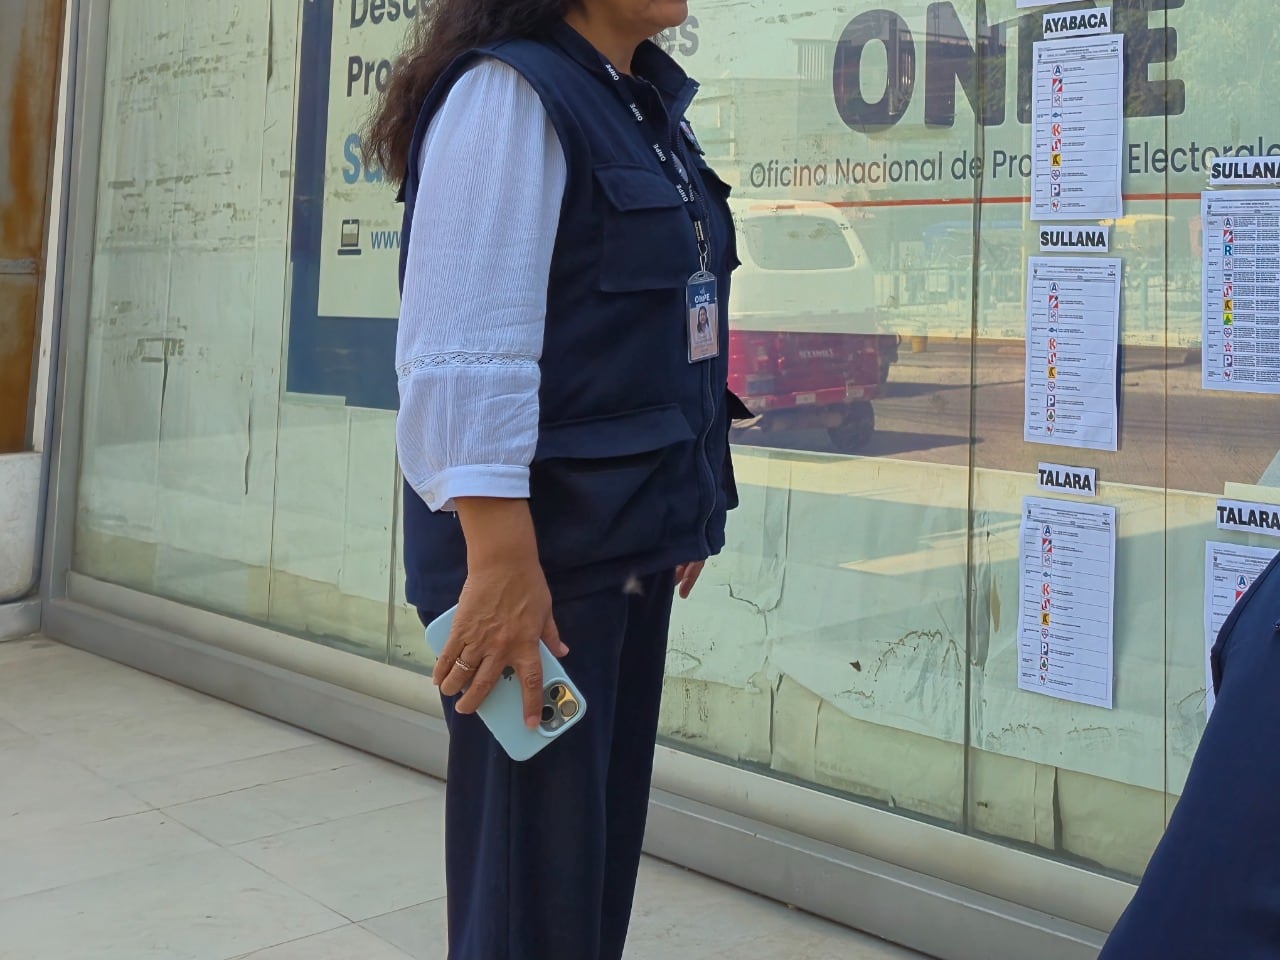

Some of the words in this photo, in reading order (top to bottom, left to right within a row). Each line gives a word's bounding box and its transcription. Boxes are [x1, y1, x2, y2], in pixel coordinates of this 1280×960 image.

[1043, 12, 1108, 34] AYABACA
[750, 155, 828, 189] Oficina
[835, 150, 946, 187] Nacional
[951, 148, 983, 180] de
[1040, 231, 1107, 247] SULLANA
[1038, 468, 1092, 491] TALARA
